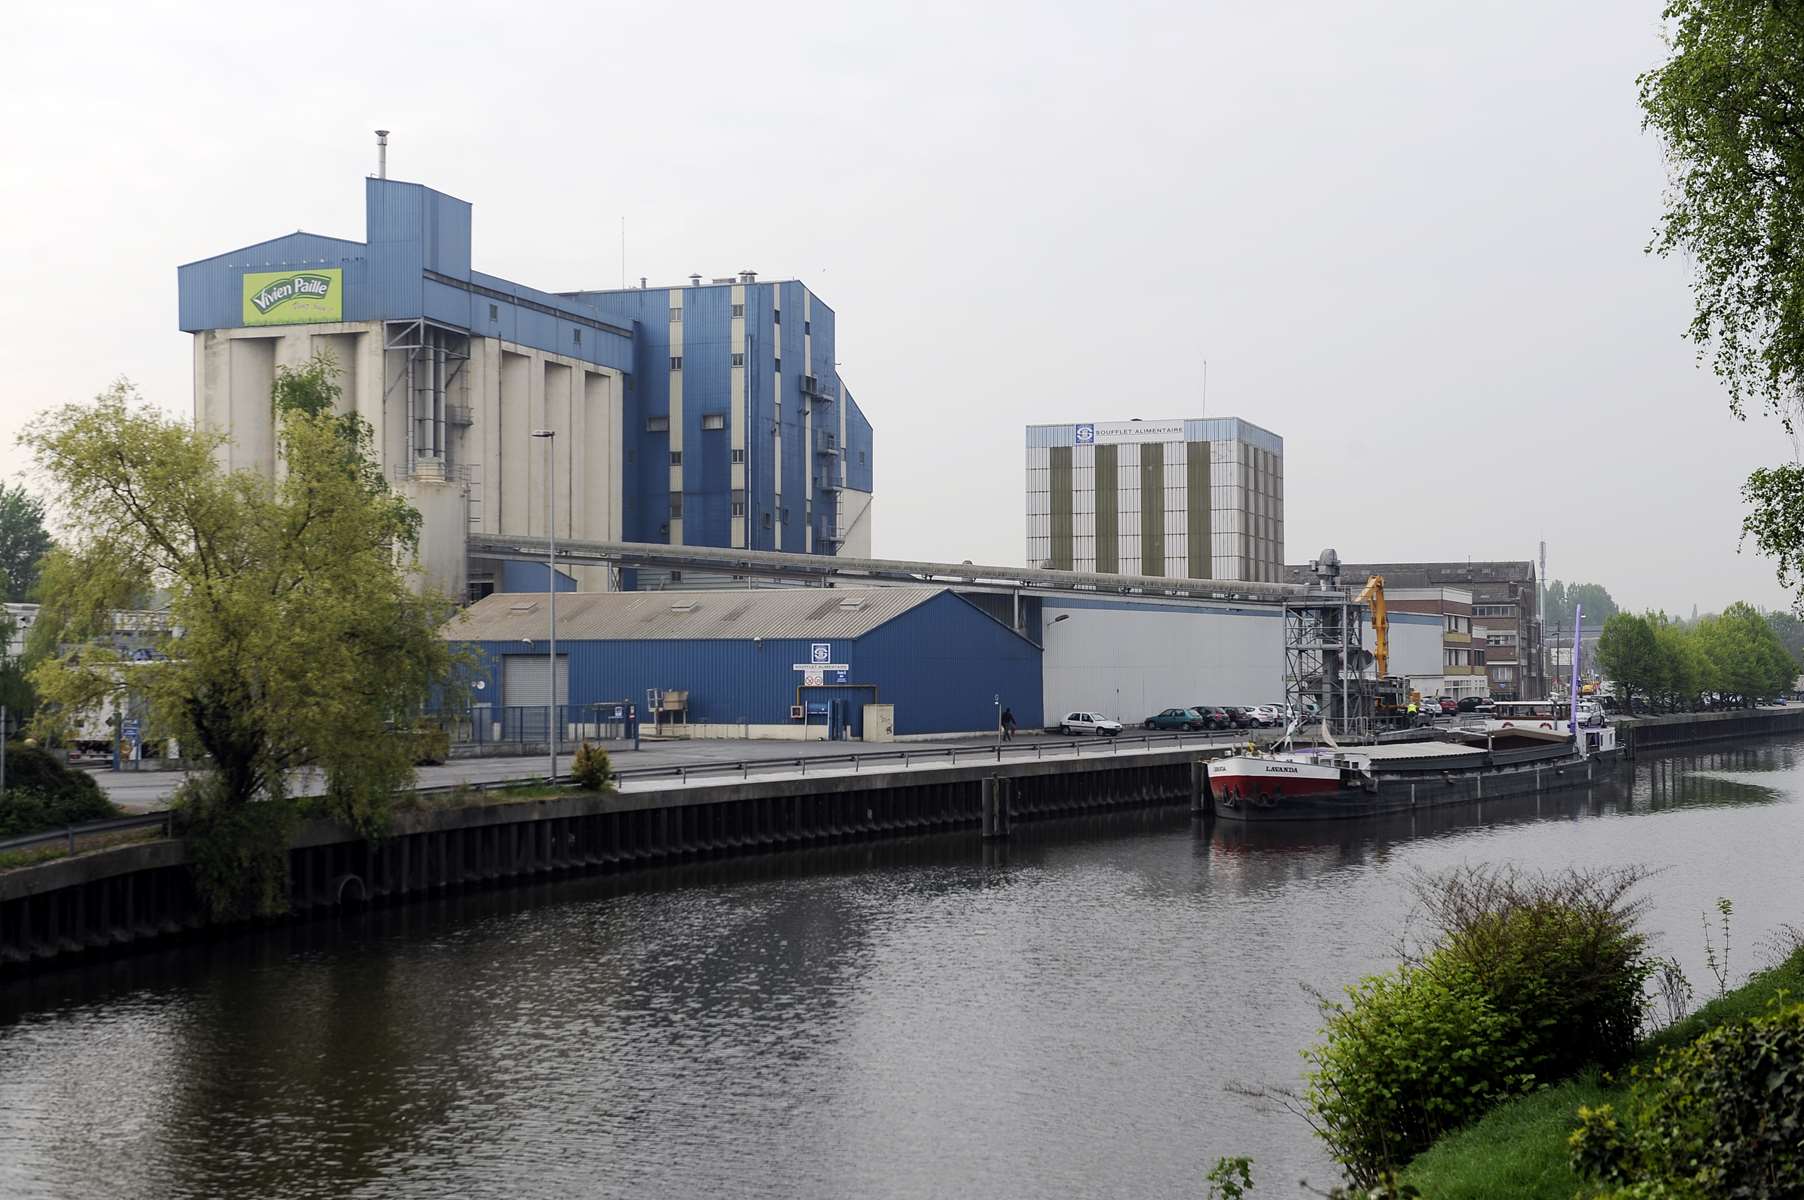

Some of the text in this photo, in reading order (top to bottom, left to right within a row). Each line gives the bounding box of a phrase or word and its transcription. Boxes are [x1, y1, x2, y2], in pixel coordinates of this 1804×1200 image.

[254, 284, 292, 309] Vivien
[294, 277, 328, 295] Paille
[1135, 426, 1184, 435] ALIMENTAIRE
[1265, 765, 1298, 773] LAVANDA
